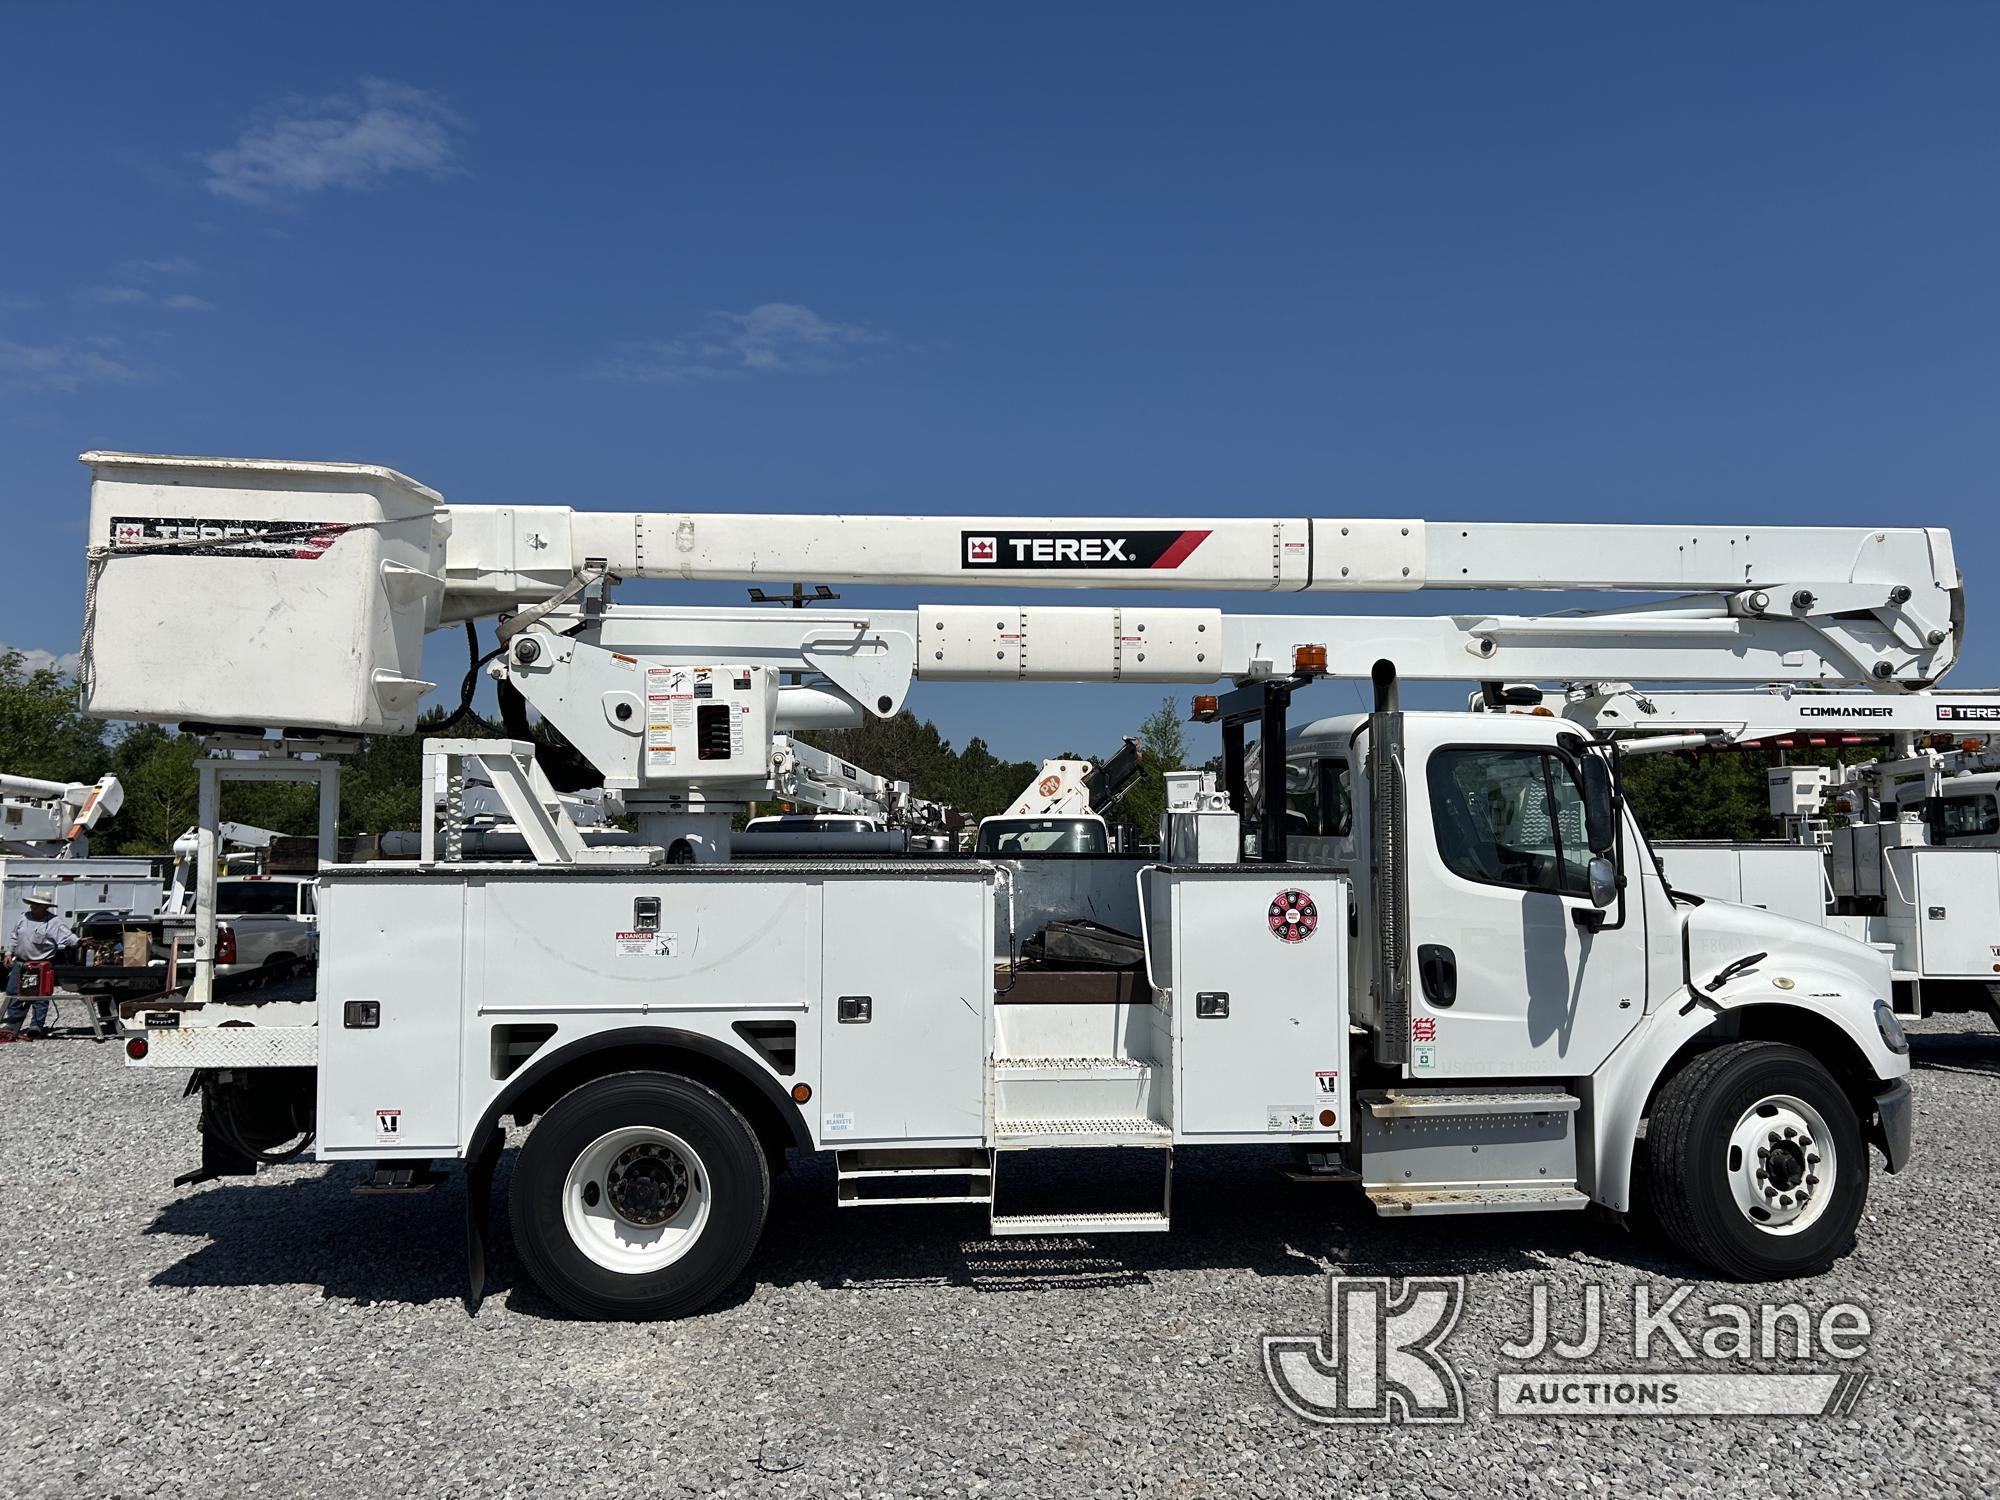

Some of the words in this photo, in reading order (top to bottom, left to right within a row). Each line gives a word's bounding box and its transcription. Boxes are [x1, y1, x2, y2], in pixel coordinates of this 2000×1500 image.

[1009, 538, 1127, 561] TEREX
[1800, 707, 1893, 717] COMMANDER
[1956, 707, 2000, 718] TERE
